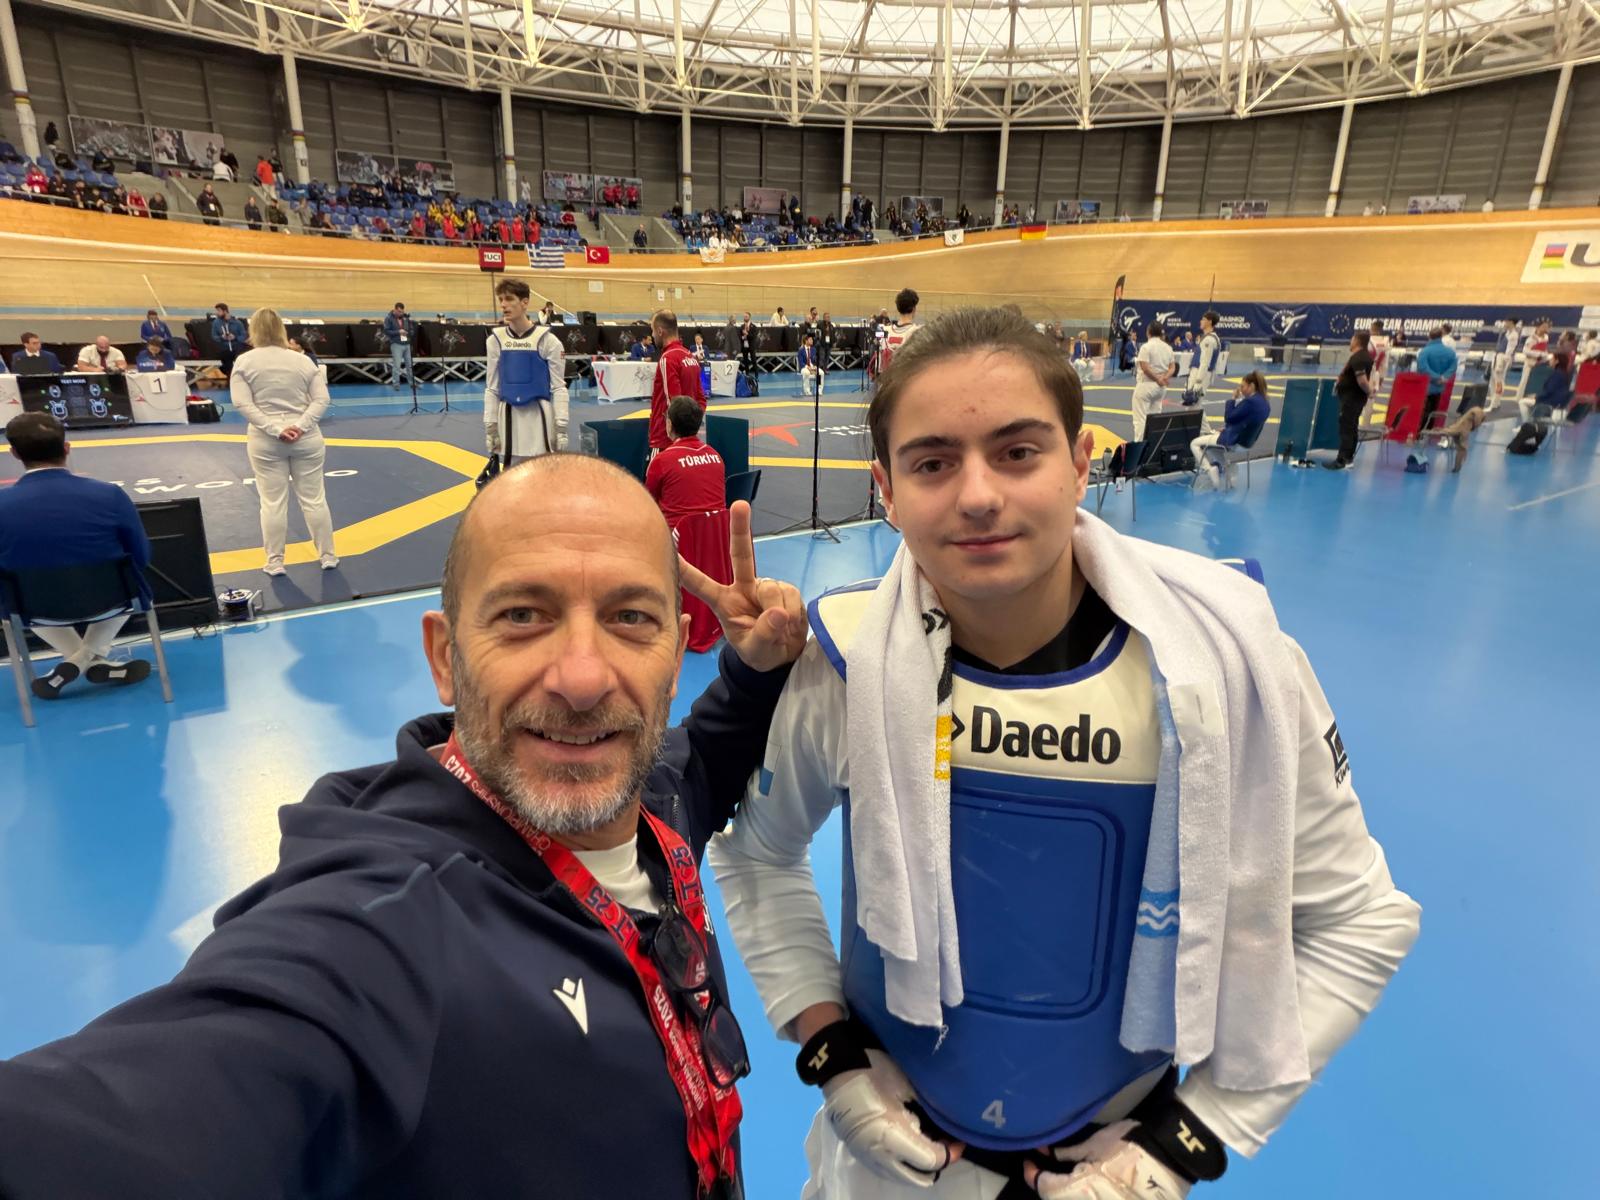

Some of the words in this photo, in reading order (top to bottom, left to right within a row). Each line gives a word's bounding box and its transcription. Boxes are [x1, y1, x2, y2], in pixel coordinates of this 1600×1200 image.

[1353, 318, 1402, 330] EUREAN
[726, 364, 733, 376] 2
[153, 377, 163, 393] 1
[677, 451, 722, 469] TÜRKİYE
[970, 704, 1122, 765] Daedo
[653, 984, 674, 1030] 2025
[980, 1100, 1007, 1130] 4
